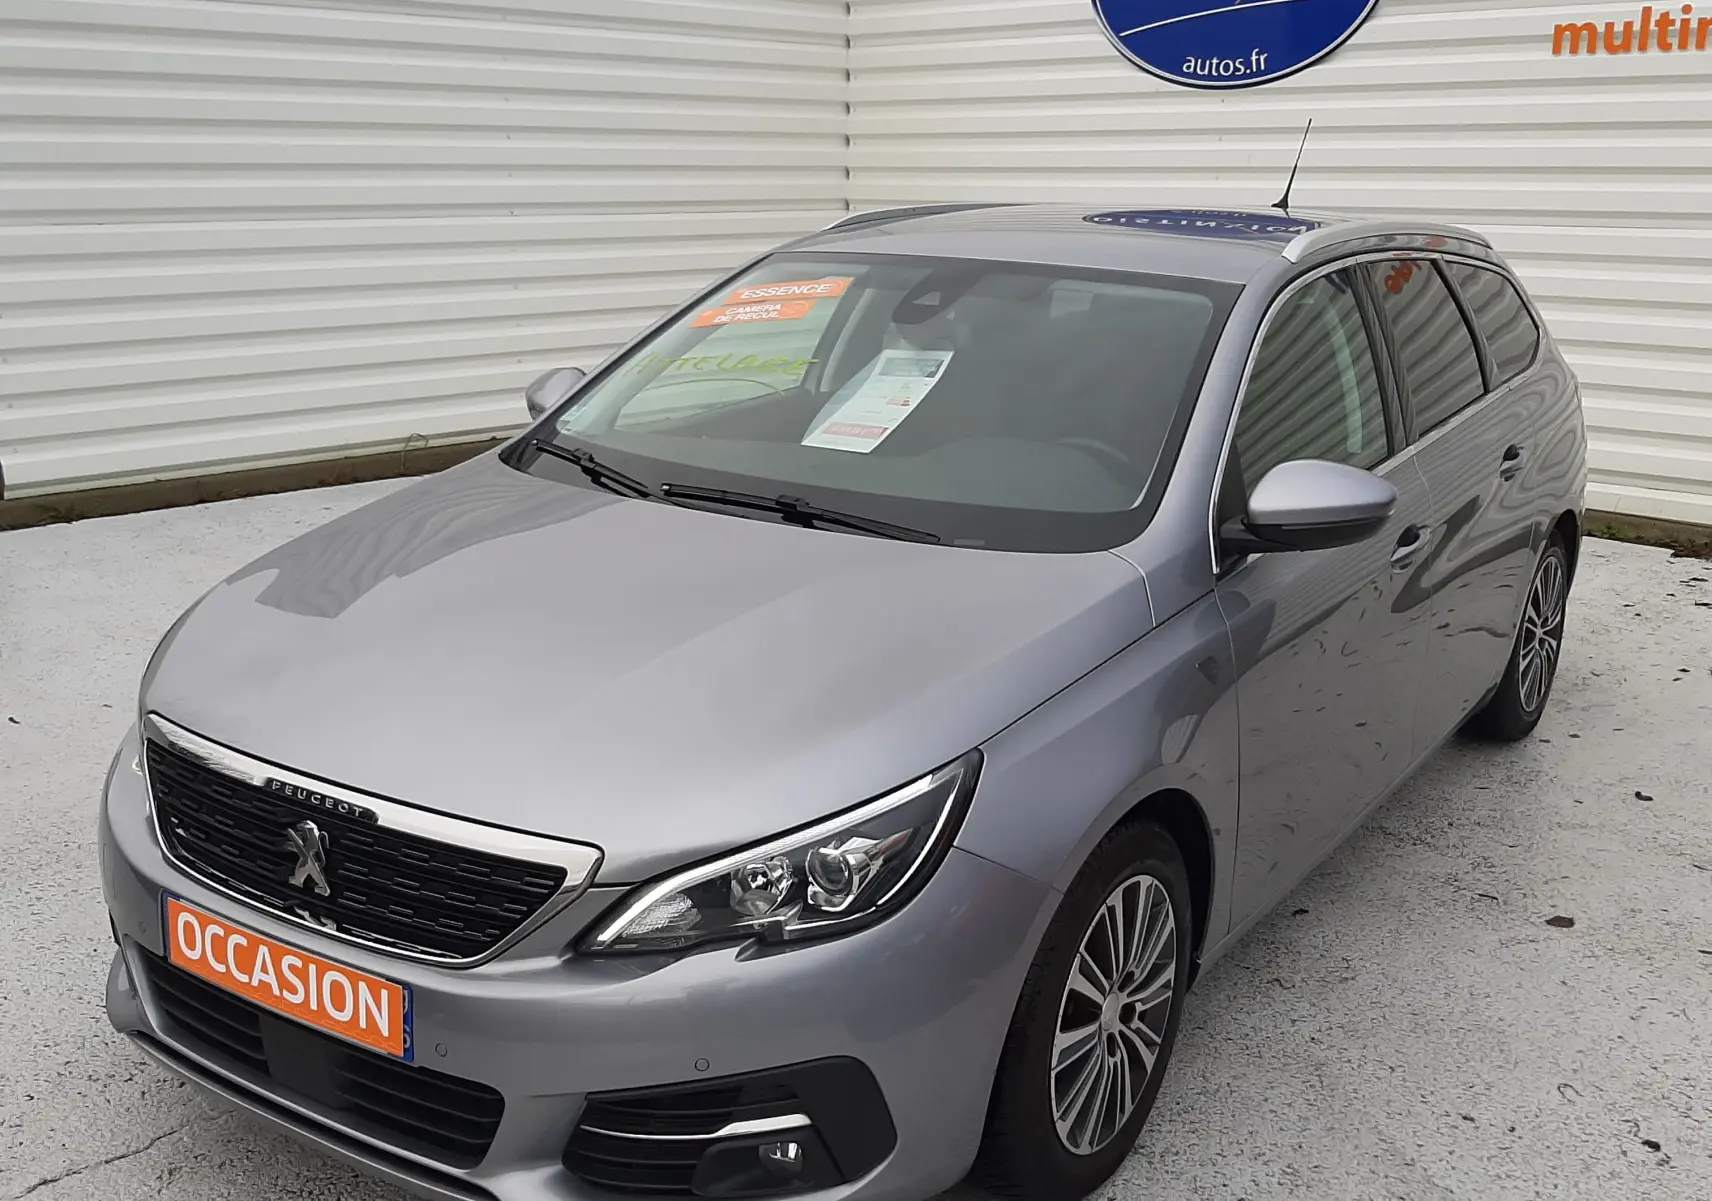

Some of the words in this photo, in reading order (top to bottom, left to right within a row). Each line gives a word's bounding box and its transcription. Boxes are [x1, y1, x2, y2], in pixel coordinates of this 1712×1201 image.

[1183, 48, 1268, 77] autos.fr
[740, 283, 833, 299] ESSENCE
[713, 314, 734, 324] DE
[734, 310, 780, 322] RECUL
[725, 303, 782, 315] CAMERA
[271, 779, 364, 817] PEUGEOT
[176, 911, 390, 1038] OCCASION
